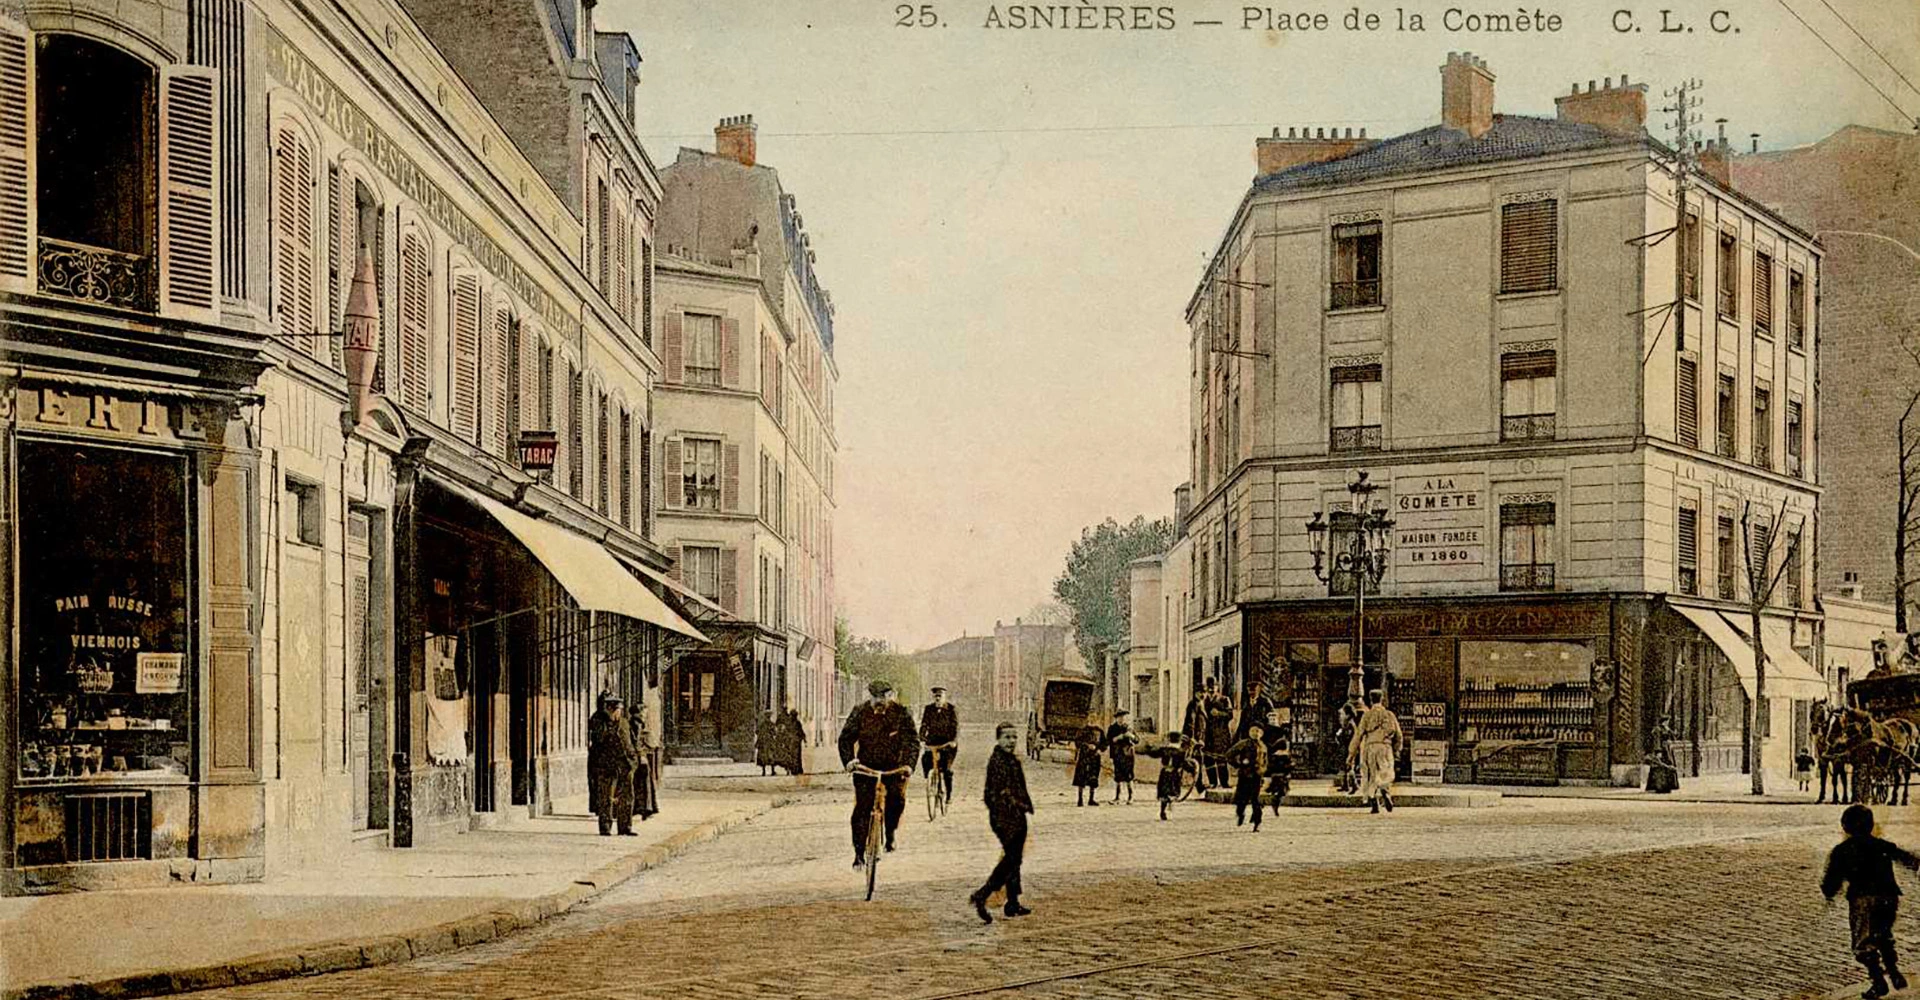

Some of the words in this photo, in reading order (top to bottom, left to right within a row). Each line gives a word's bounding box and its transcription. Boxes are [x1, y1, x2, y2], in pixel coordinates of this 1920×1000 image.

[281, 43, 354, 142] TABAC
[365, 120, 469, 246] RESTAURANT
[520, 447, 553, 464] TABAC
[1423, 480, 1433, 490] A
[1438, 479, 1455, 489] LA
[1402, 534, 1436, 544] MAISON
[1411, 552, 1424, 562] EN
[1432, 550, 1468, 561] 1860
[56, 595, 89, 612] PAIN
[108, 595, 153, 616] RUSSE
[71, 634, 141, 649] VIENNOIS
[1619, 618, 1633, 733] GRAINETERIE
[1415, 704, 1444, 716] MOTO
